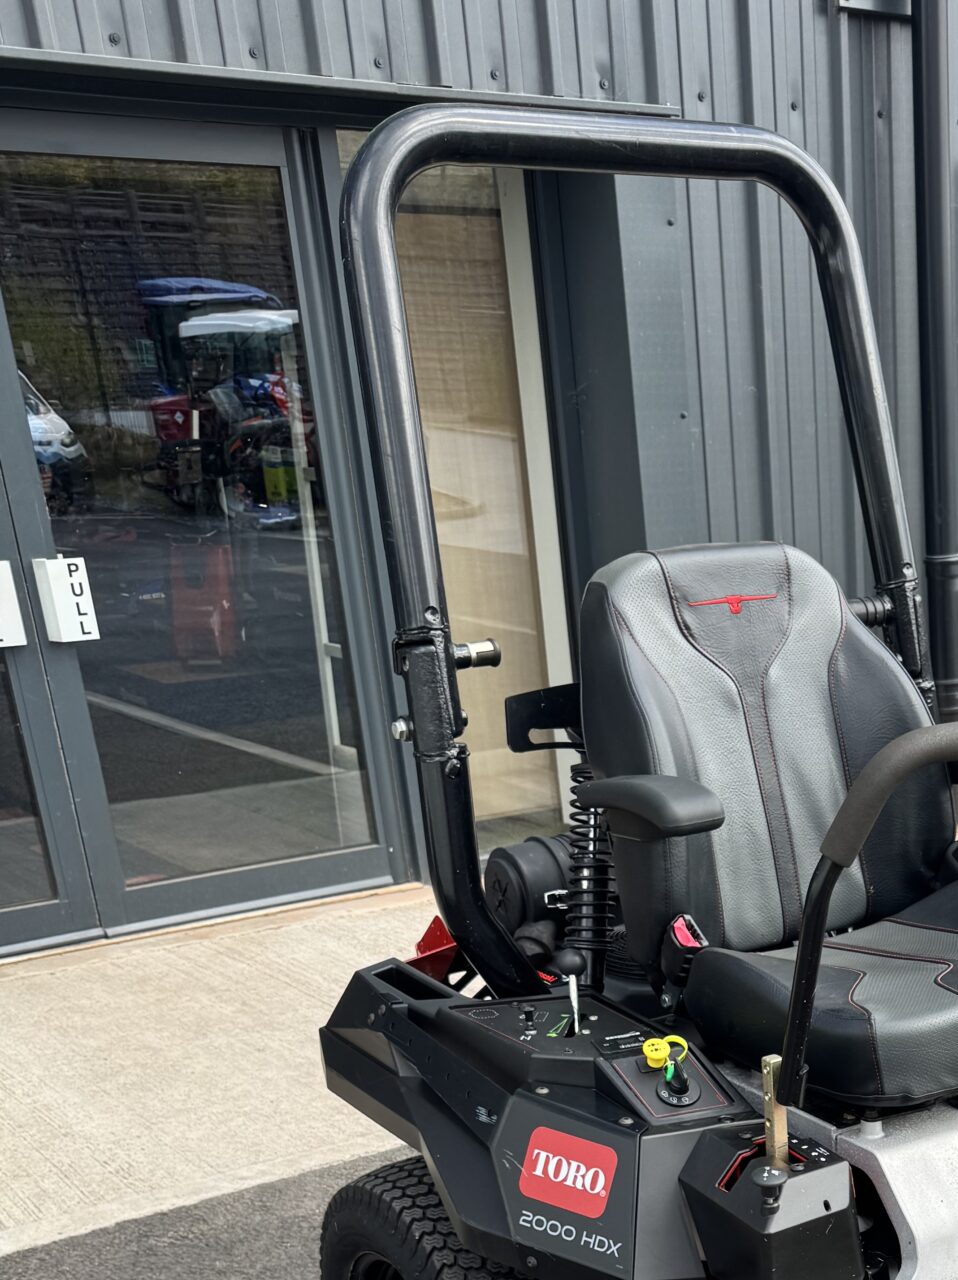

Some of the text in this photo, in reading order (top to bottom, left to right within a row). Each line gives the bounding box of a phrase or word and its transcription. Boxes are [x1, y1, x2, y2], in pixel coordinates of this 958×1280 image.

[67, 562, 92, 635] PULL
[532, 1148, 606, 1195] TORO
[519, 1210, 622, 1258] 2000 HDX
